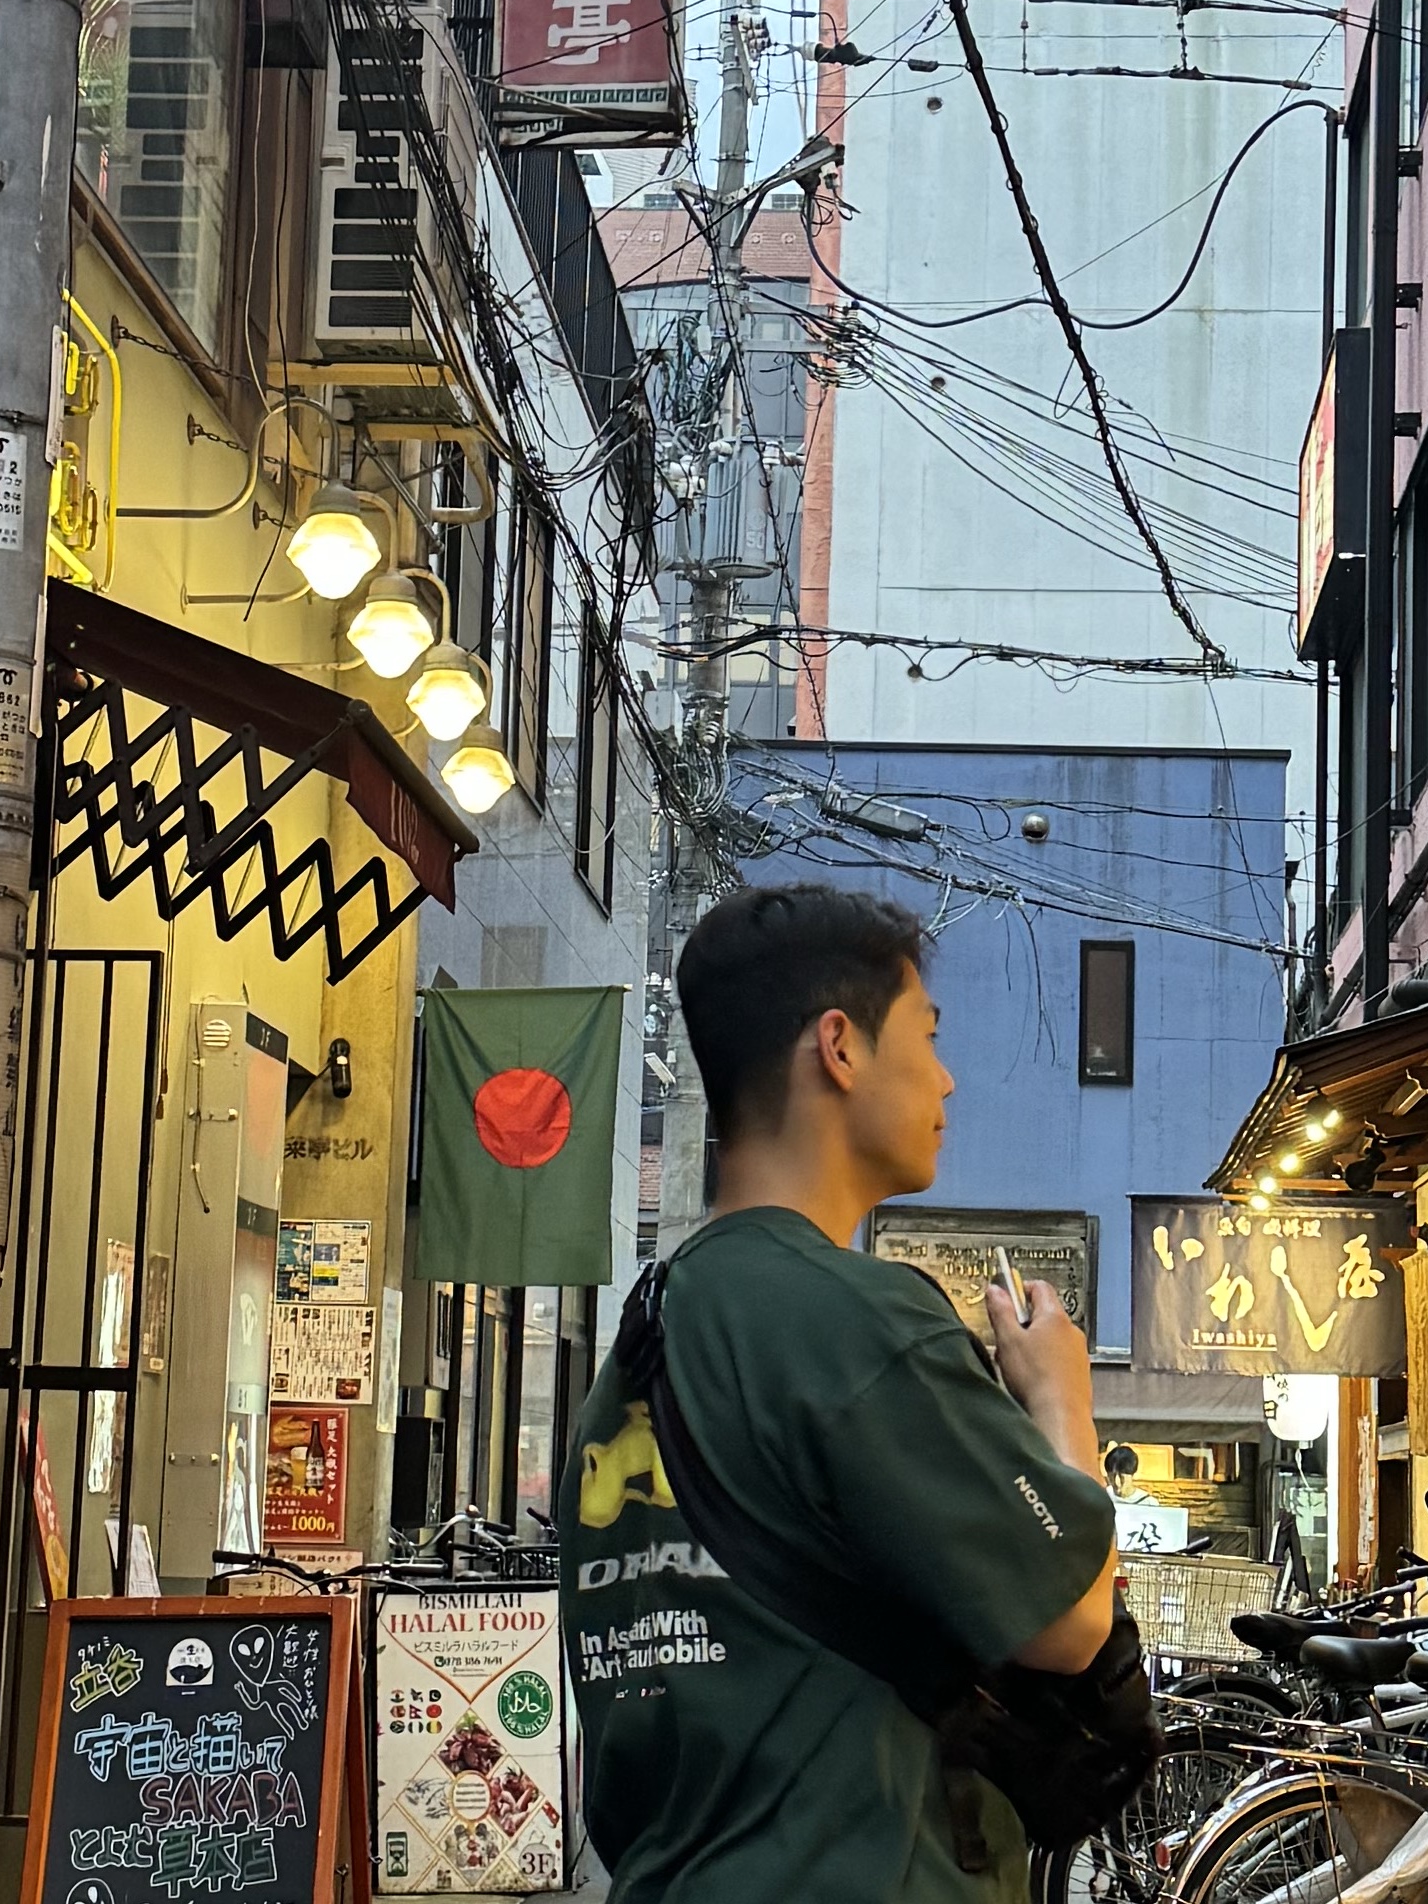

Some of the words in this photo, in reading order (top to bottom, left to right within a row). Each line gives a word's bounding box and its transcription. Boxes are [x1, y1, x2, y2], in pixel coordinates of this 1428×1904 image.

[1192, 1329, 1277, 1347] Iwashiya
[419, 1594, 522, 1610] BISMILLAH
[390, 1612, 473, 1633] HALAL
[479, 1611, 545, 1632] FOOD
[580, 1631, 603, 1655] In
[653, 1610, 708, 1638] With
[74, 1712, 287, 1782] 宇宙と描いて
[140, 1770, 306, 1827] SAKABA
[521, 1851, 555, 1875] 3F
